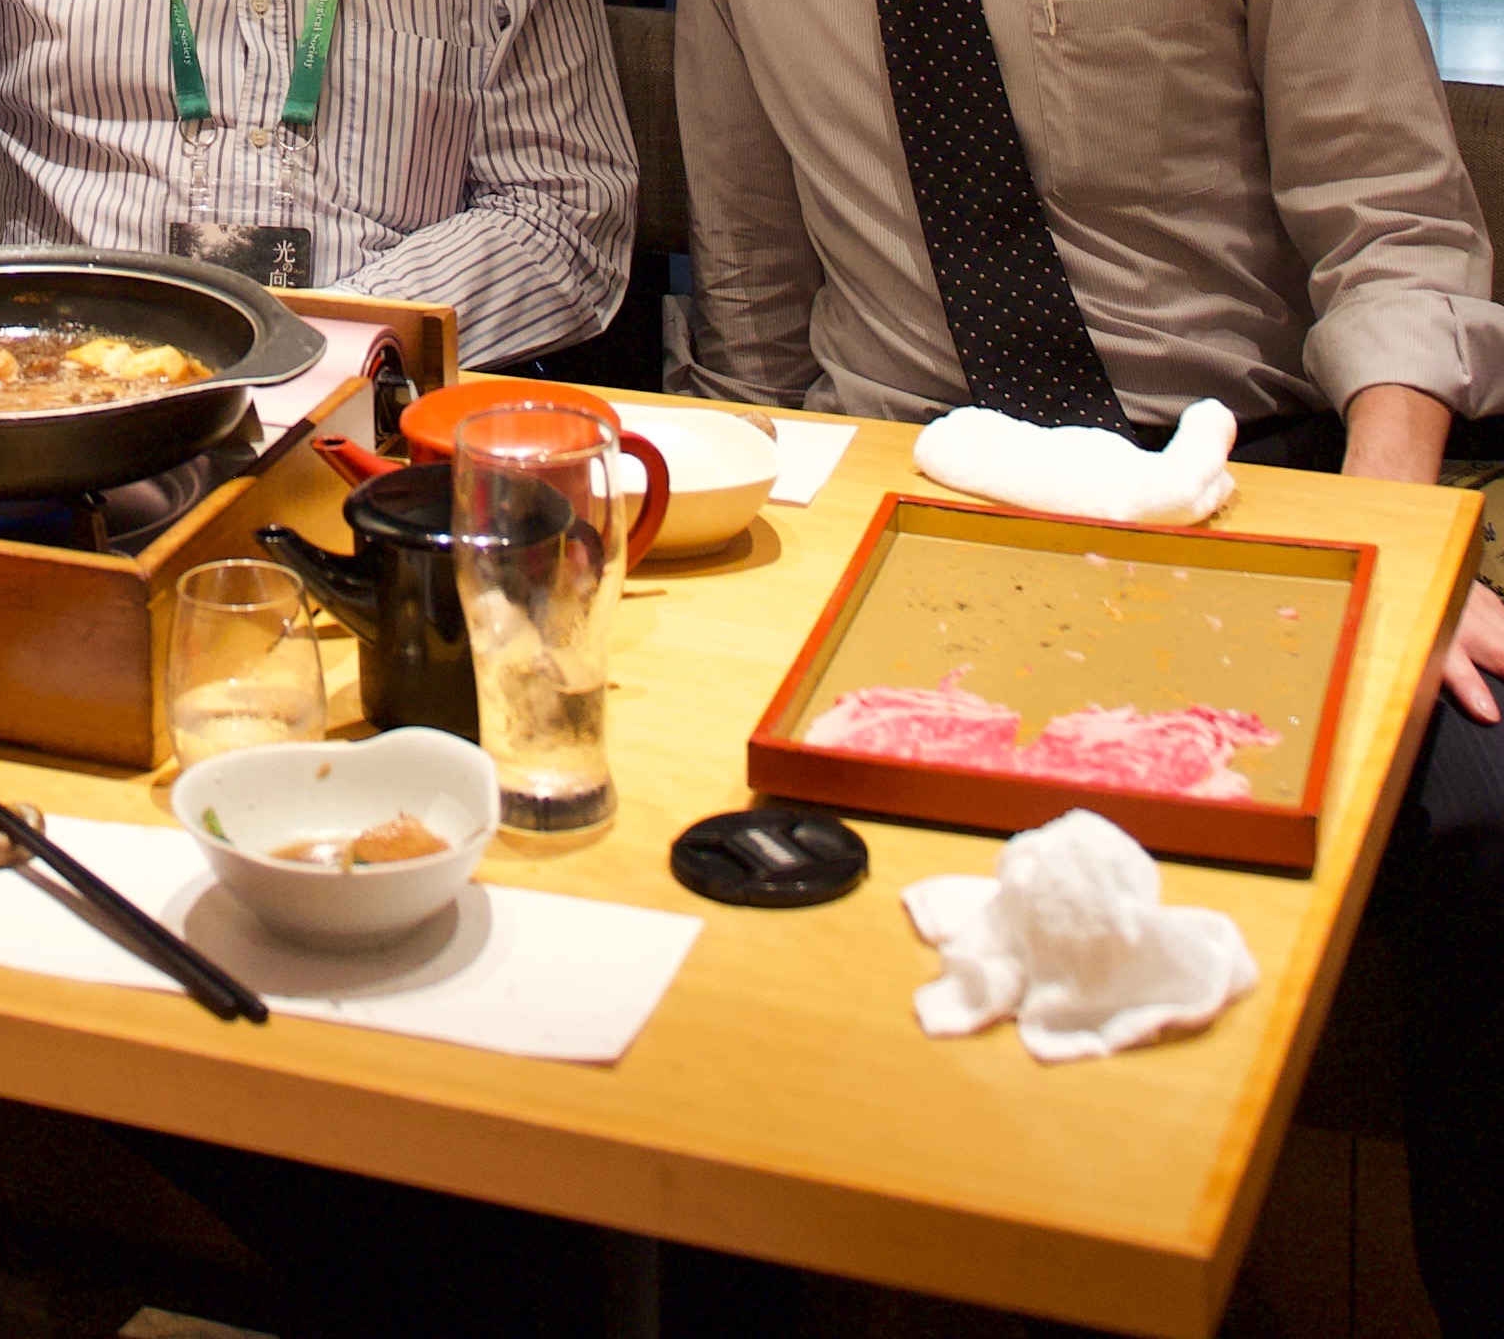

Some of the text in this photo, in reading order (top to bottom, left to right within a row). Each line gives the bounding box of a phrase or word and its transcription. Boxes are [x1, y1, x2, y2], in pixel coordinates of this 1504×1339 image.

[303, 33, 320, 70] Society
[269, 239, 296, 289] 光の向
